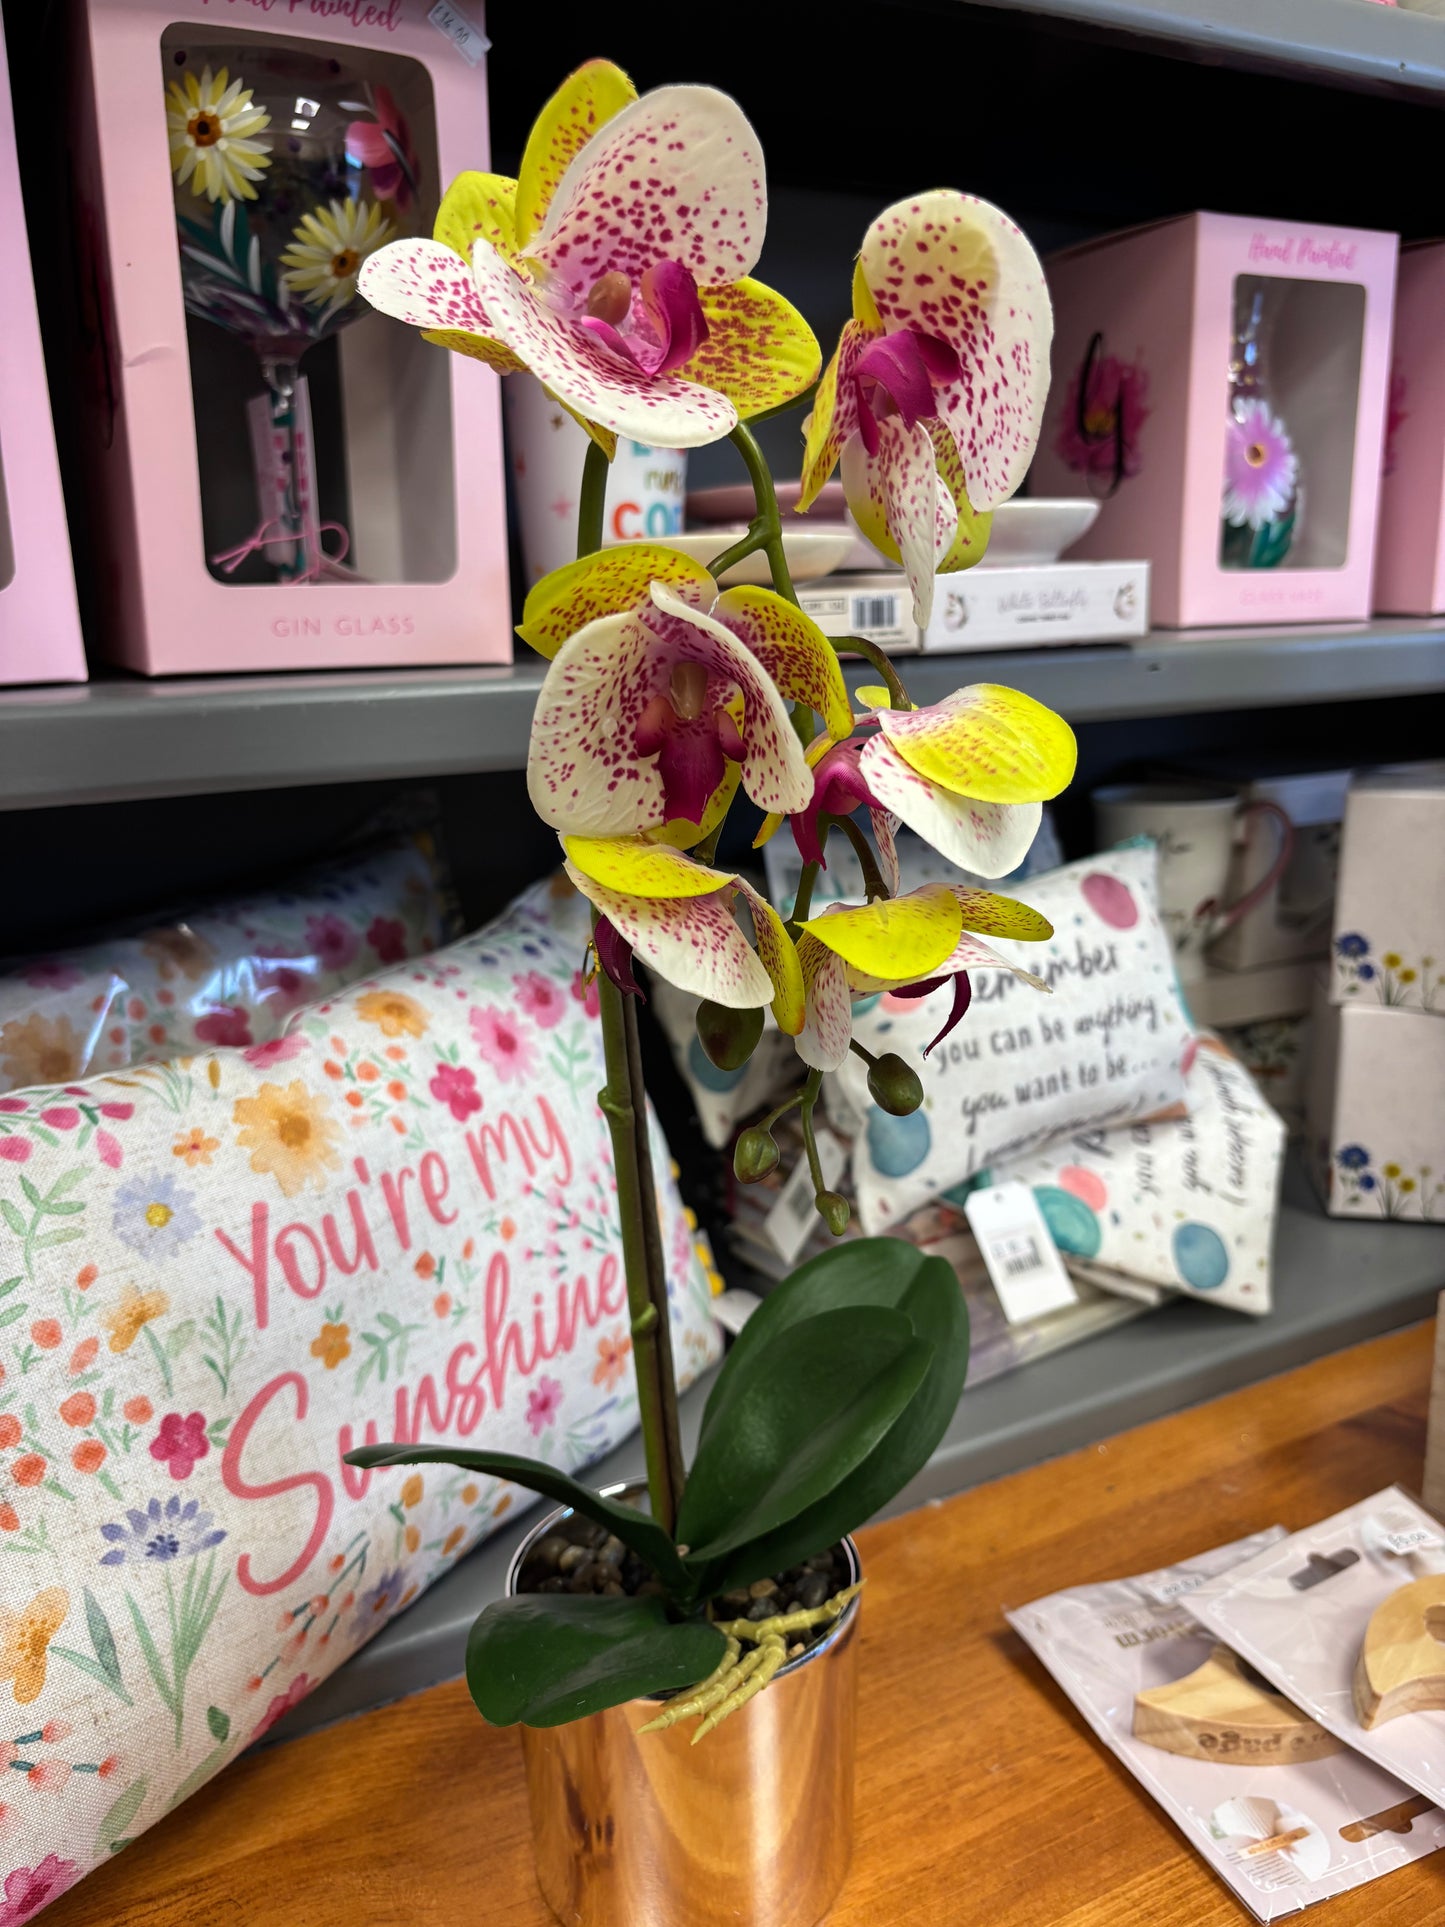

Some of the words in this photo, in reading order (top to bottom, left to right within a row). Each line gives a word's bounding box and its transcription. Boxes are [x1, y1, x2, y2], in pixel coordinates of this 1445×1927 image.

[271, 617, 321, 638] GIN
[334, 614, 415, 637] GLASS
[933, 1040, 979, 1074] you
[991, 1029, 1032, 1055] can
[1038, 1016, 1066, 1042] be
[1074, 997, 1159, 1046] anything
[962, 1095, 1010, 1137] you
[1015, 1067, 1075, 1105] want
[1078, 1061, 1098, 1088] to
[215, 1149, 459, 1330] You're
[465, 1094, 574, 1201] my
[222, 1252, 628, 1596] Sunshine
[1198, 1731, 1283, 1755] page
